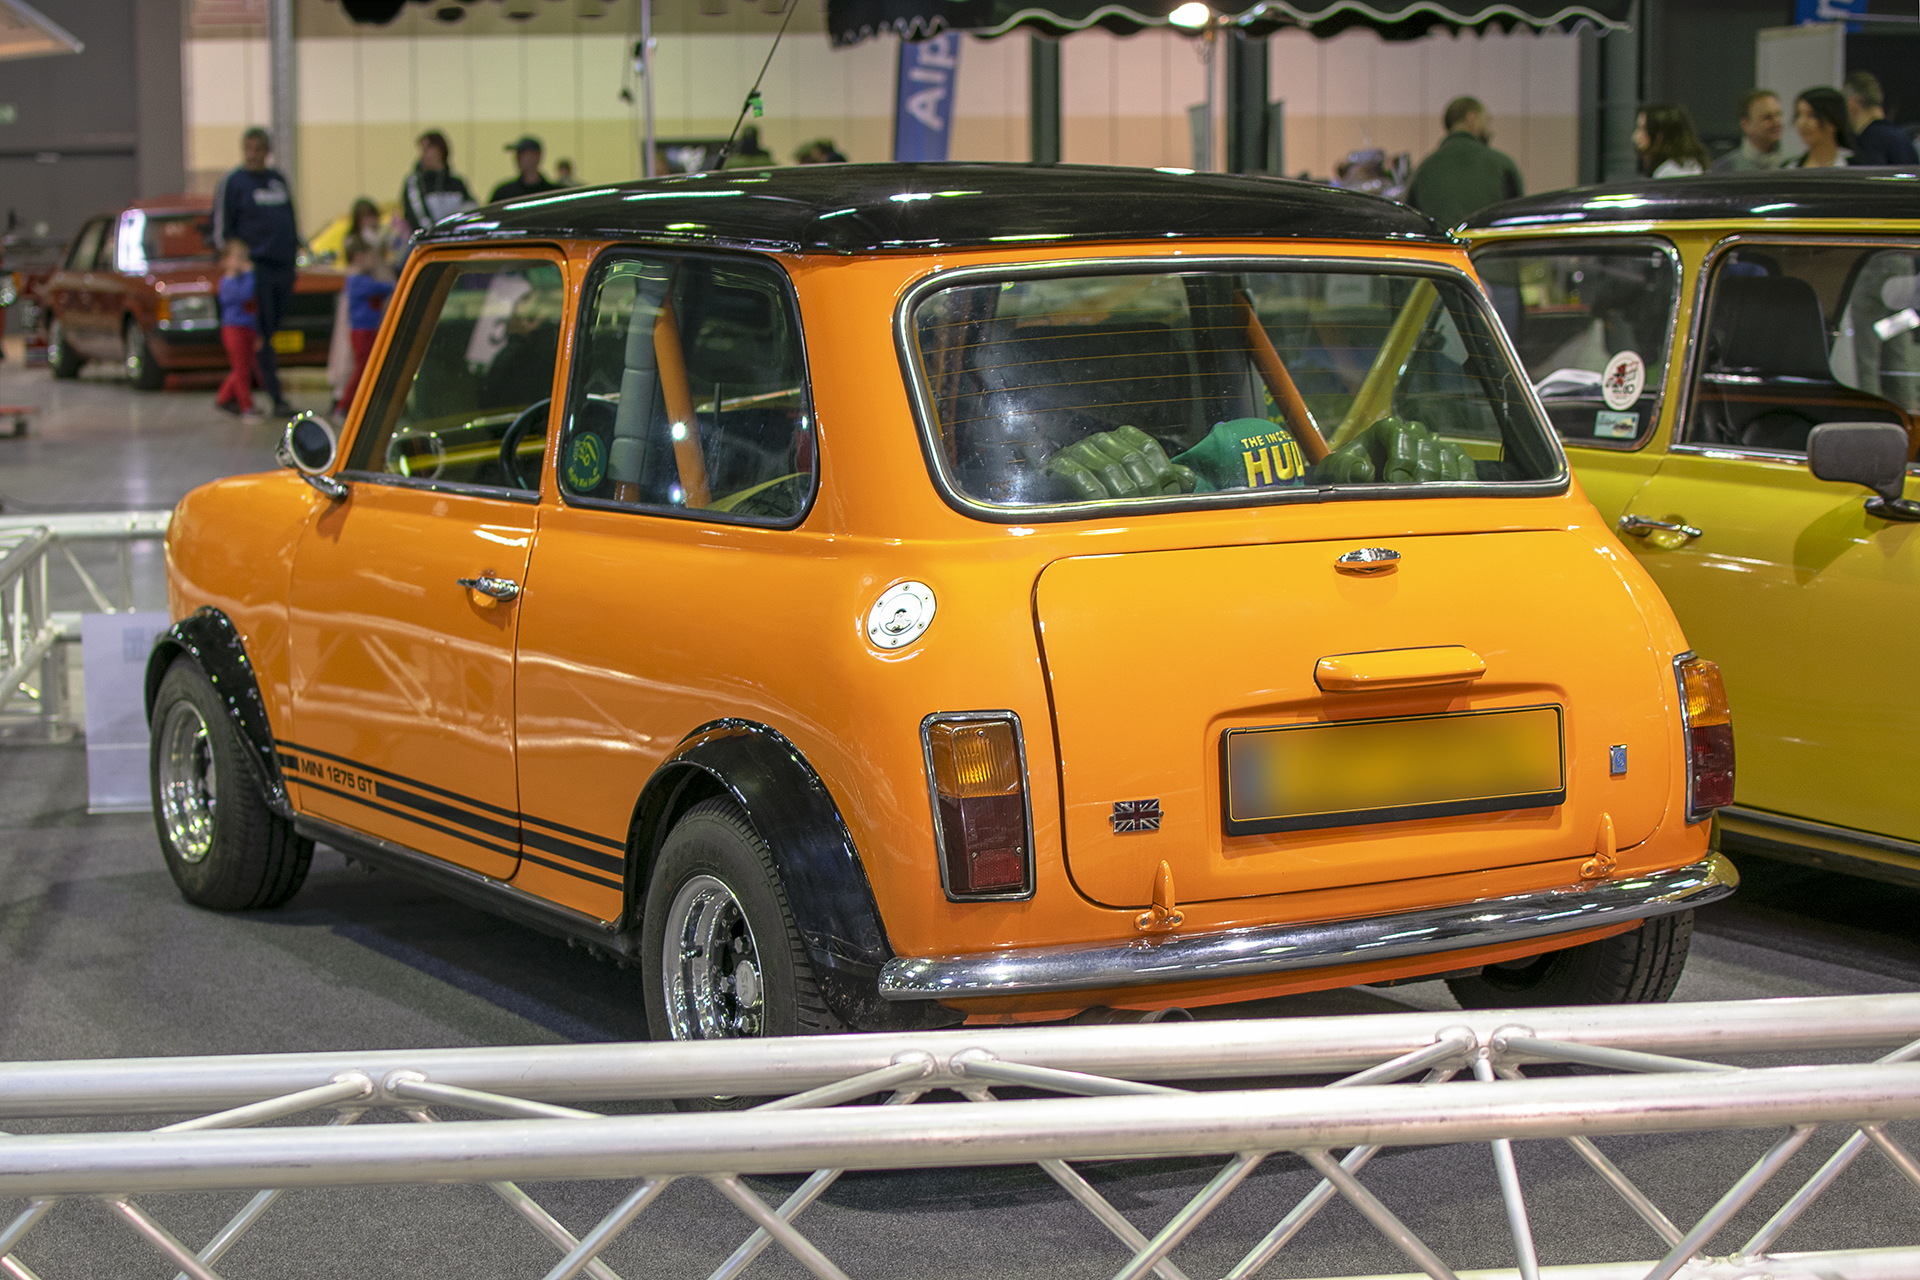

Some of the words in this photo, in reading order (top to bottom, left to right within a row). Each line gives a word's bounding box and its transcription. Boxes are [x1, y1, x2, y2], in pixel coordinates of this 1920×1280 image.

[1241, 435, 1265, 449] THE
[301, 758, 324, 779] MINI
[327, 765, 355, 789] 1275
[357, 775, 373, 795] GT
